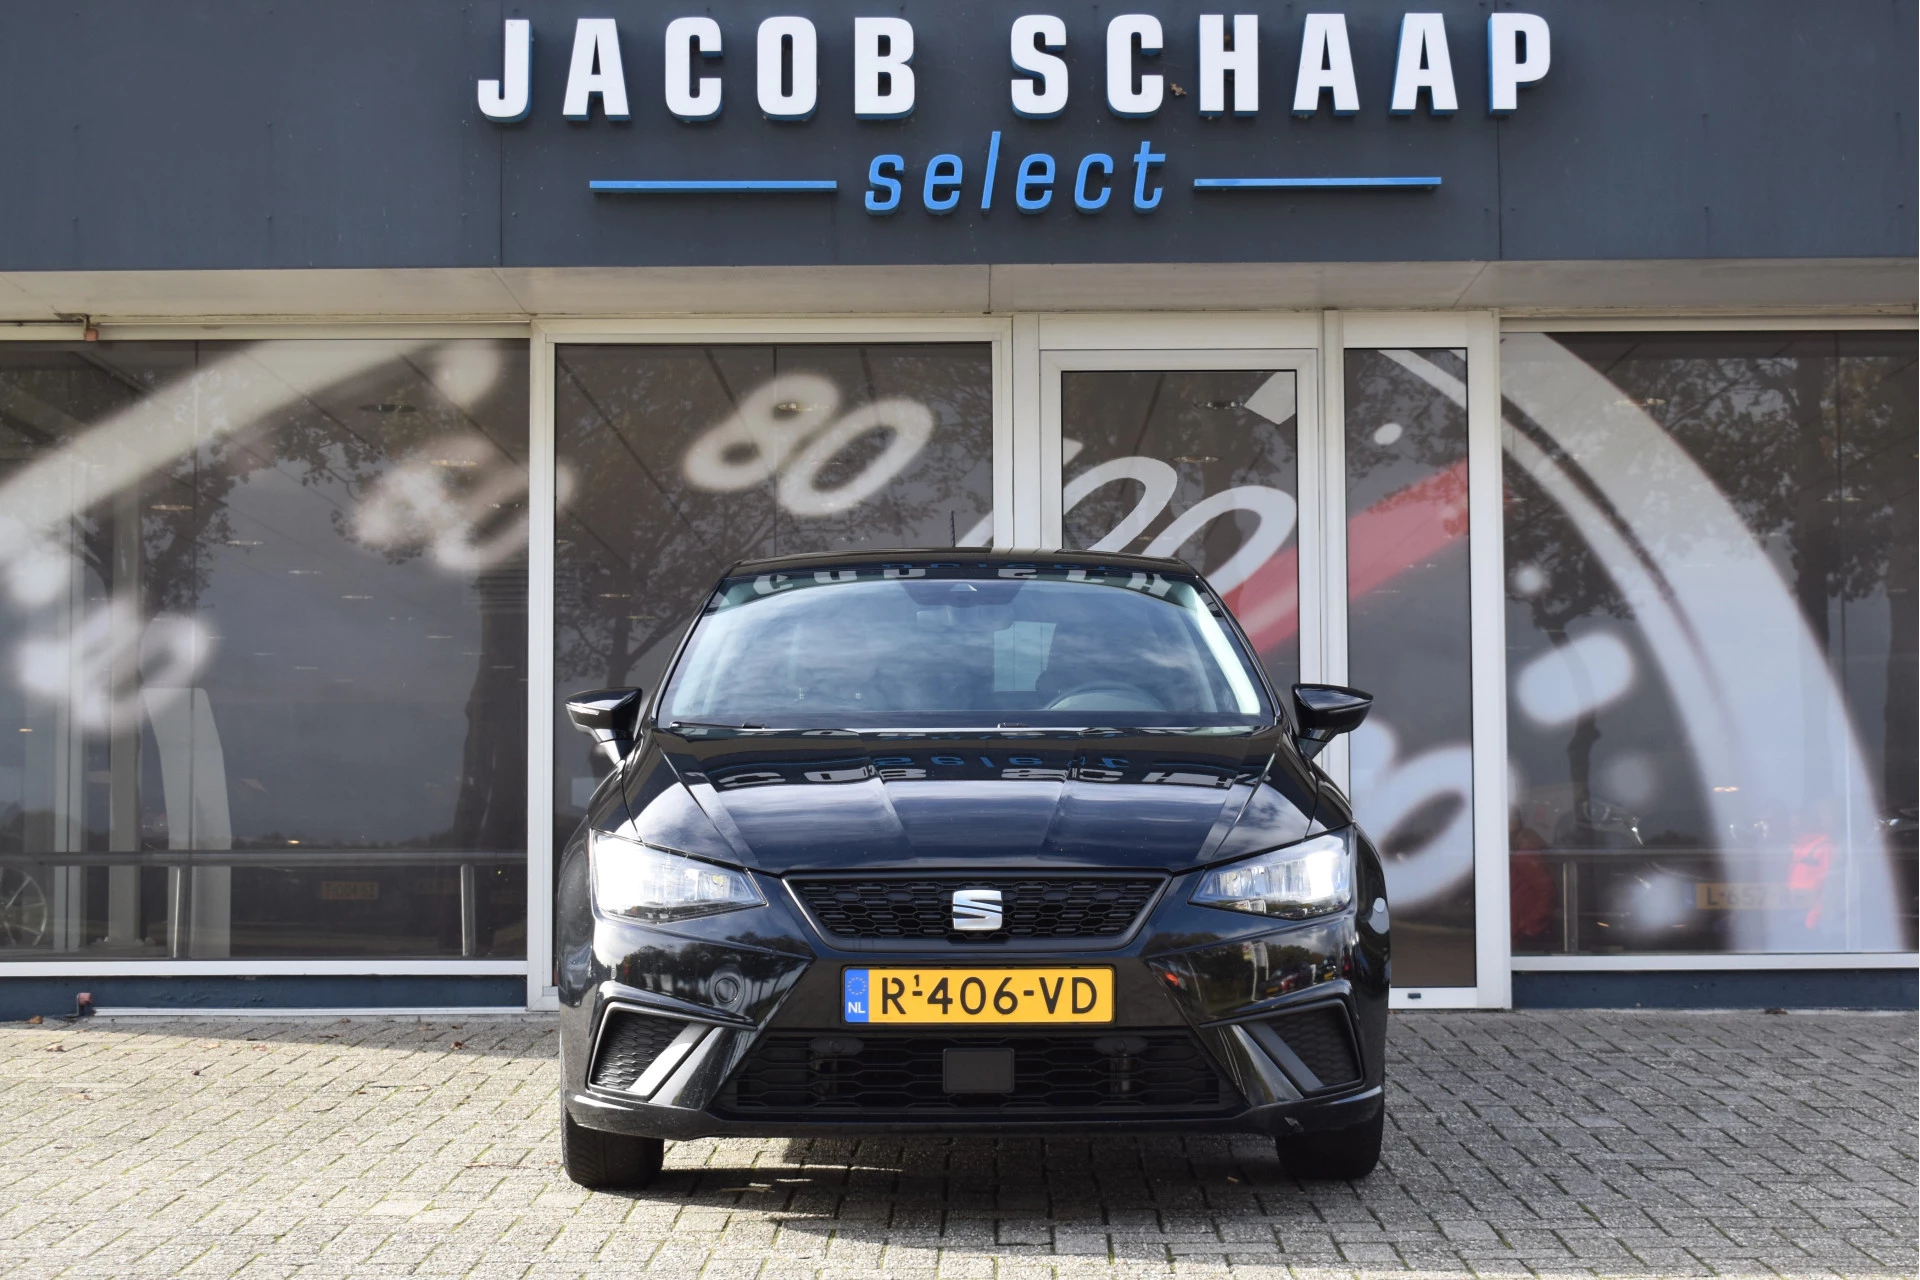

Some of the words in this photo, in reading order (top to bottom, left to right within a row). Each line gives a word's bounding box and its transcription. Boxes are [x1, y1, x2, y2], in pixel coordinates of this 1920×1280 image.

[477, 15, 916, 121] JACOB
[1010, 12, 1551, 118] SCHAAP
[864, 131, 1166, 215] select
[683, 373, 934, 517] 80
[848, 1001, 866, 1014] NL
